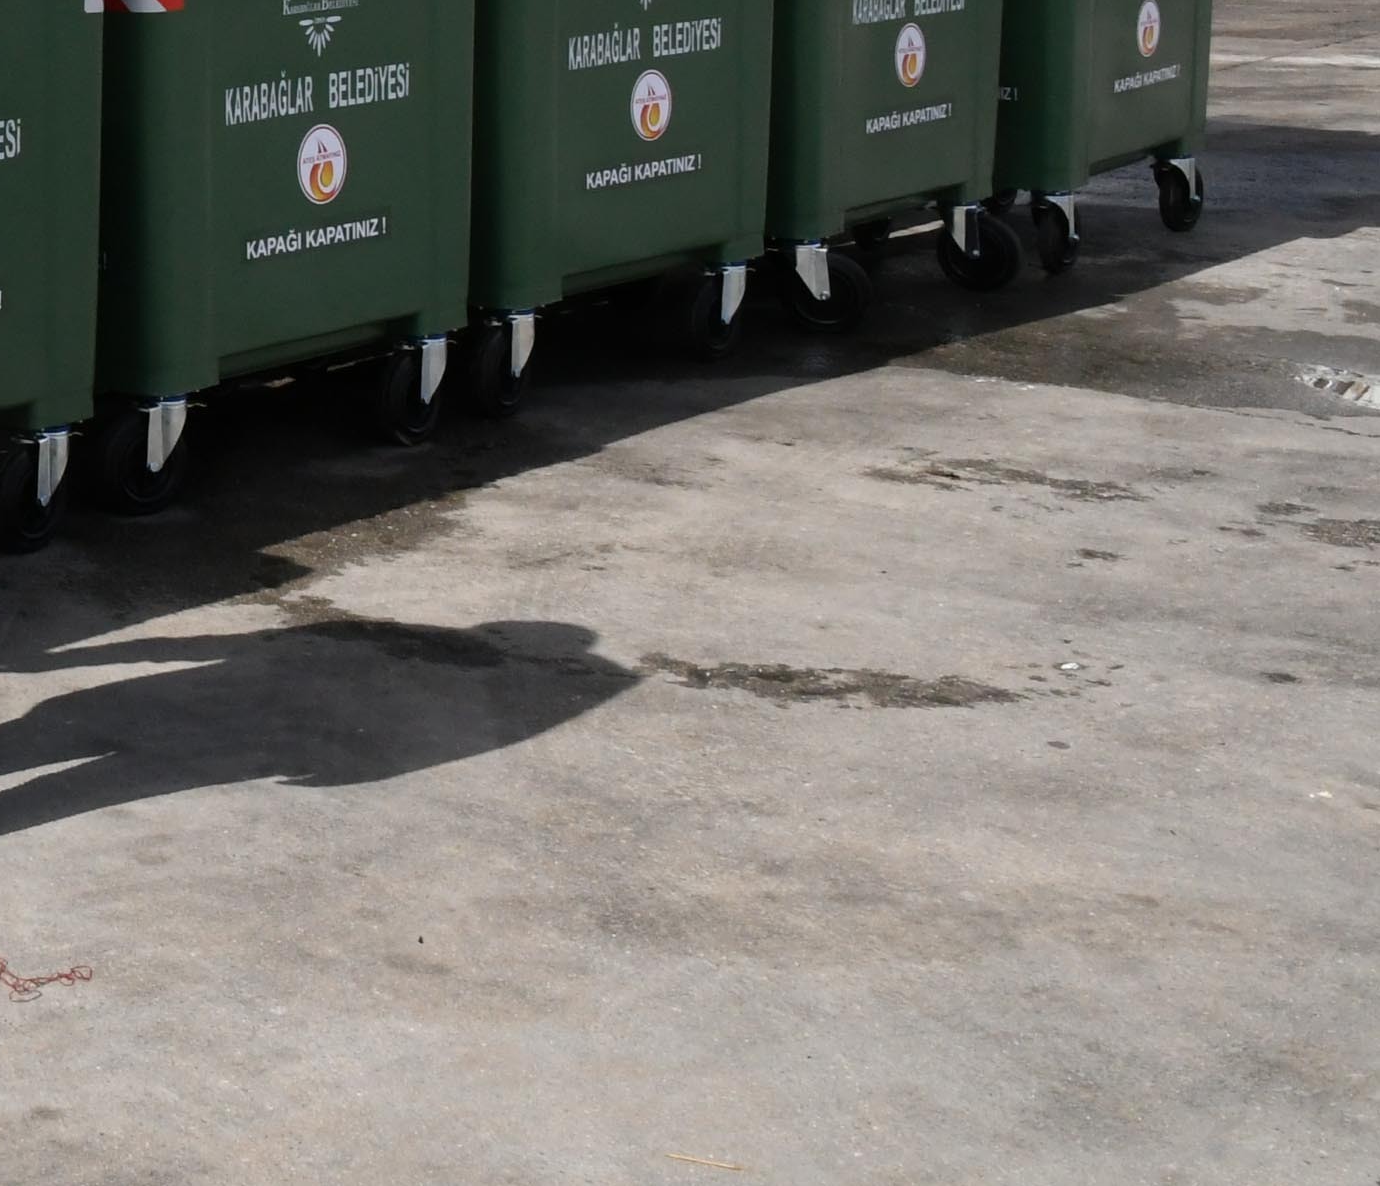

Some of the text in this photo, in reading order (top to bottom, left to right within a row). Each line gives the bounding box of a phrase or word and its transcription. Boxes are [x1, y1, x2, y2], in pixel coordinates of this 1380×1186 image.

[568, 22, 641, 71] KARABAĞLAR
[225, 71, 314, 126] KARABAĞLAR
[865, 108, 901, 134] KAPAĞI
[586, 163, 632, 190] KAPAĞI
[634, 154, 696, 181] KAPATINIZ
[246, 216, 387, 260] KAPAĞI KAPATINIZ !
